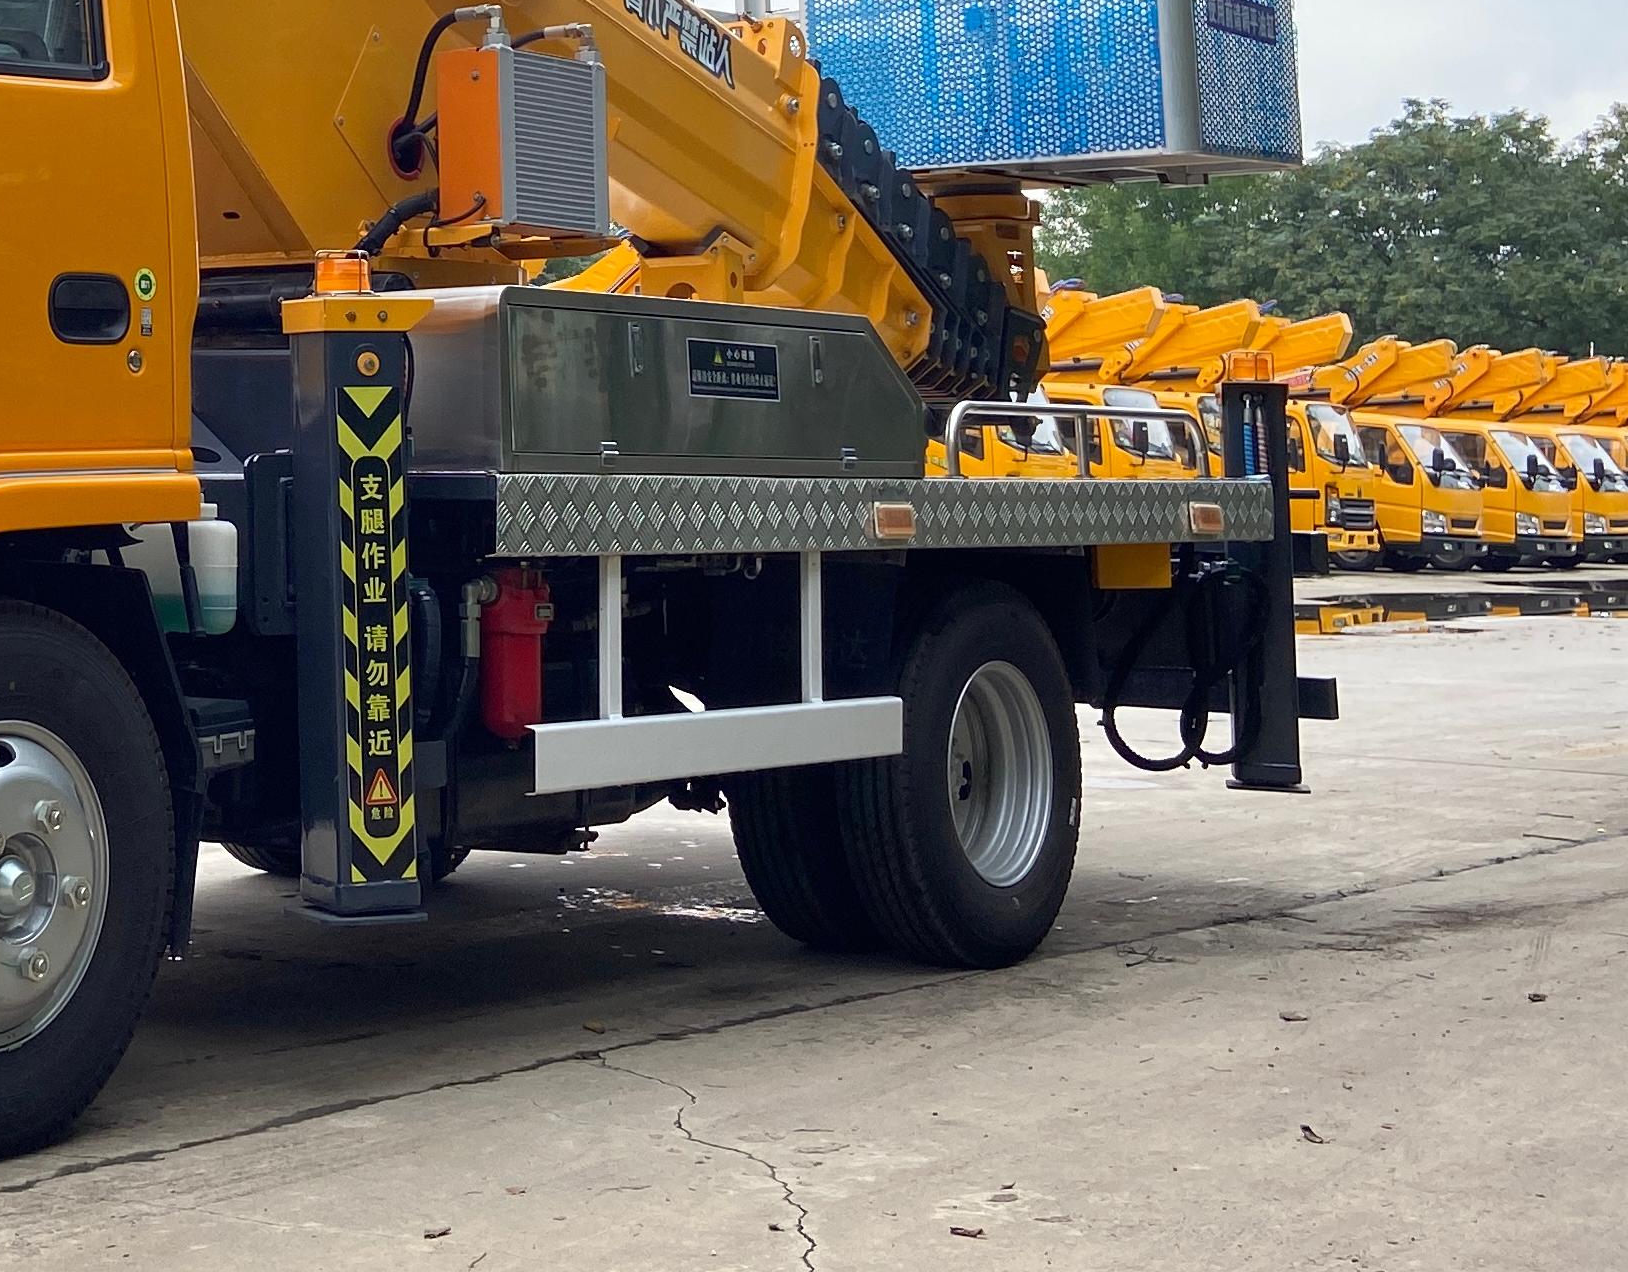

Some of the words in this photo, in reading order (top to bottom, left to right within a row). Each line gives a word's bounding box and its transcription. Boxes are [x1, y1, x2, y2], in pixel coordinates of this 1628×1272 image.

[360, 473, 387, 604] 支腿作业
[364, 624, 393, 758] 请勿靠近
[371, 806, 394, 820] 危险
